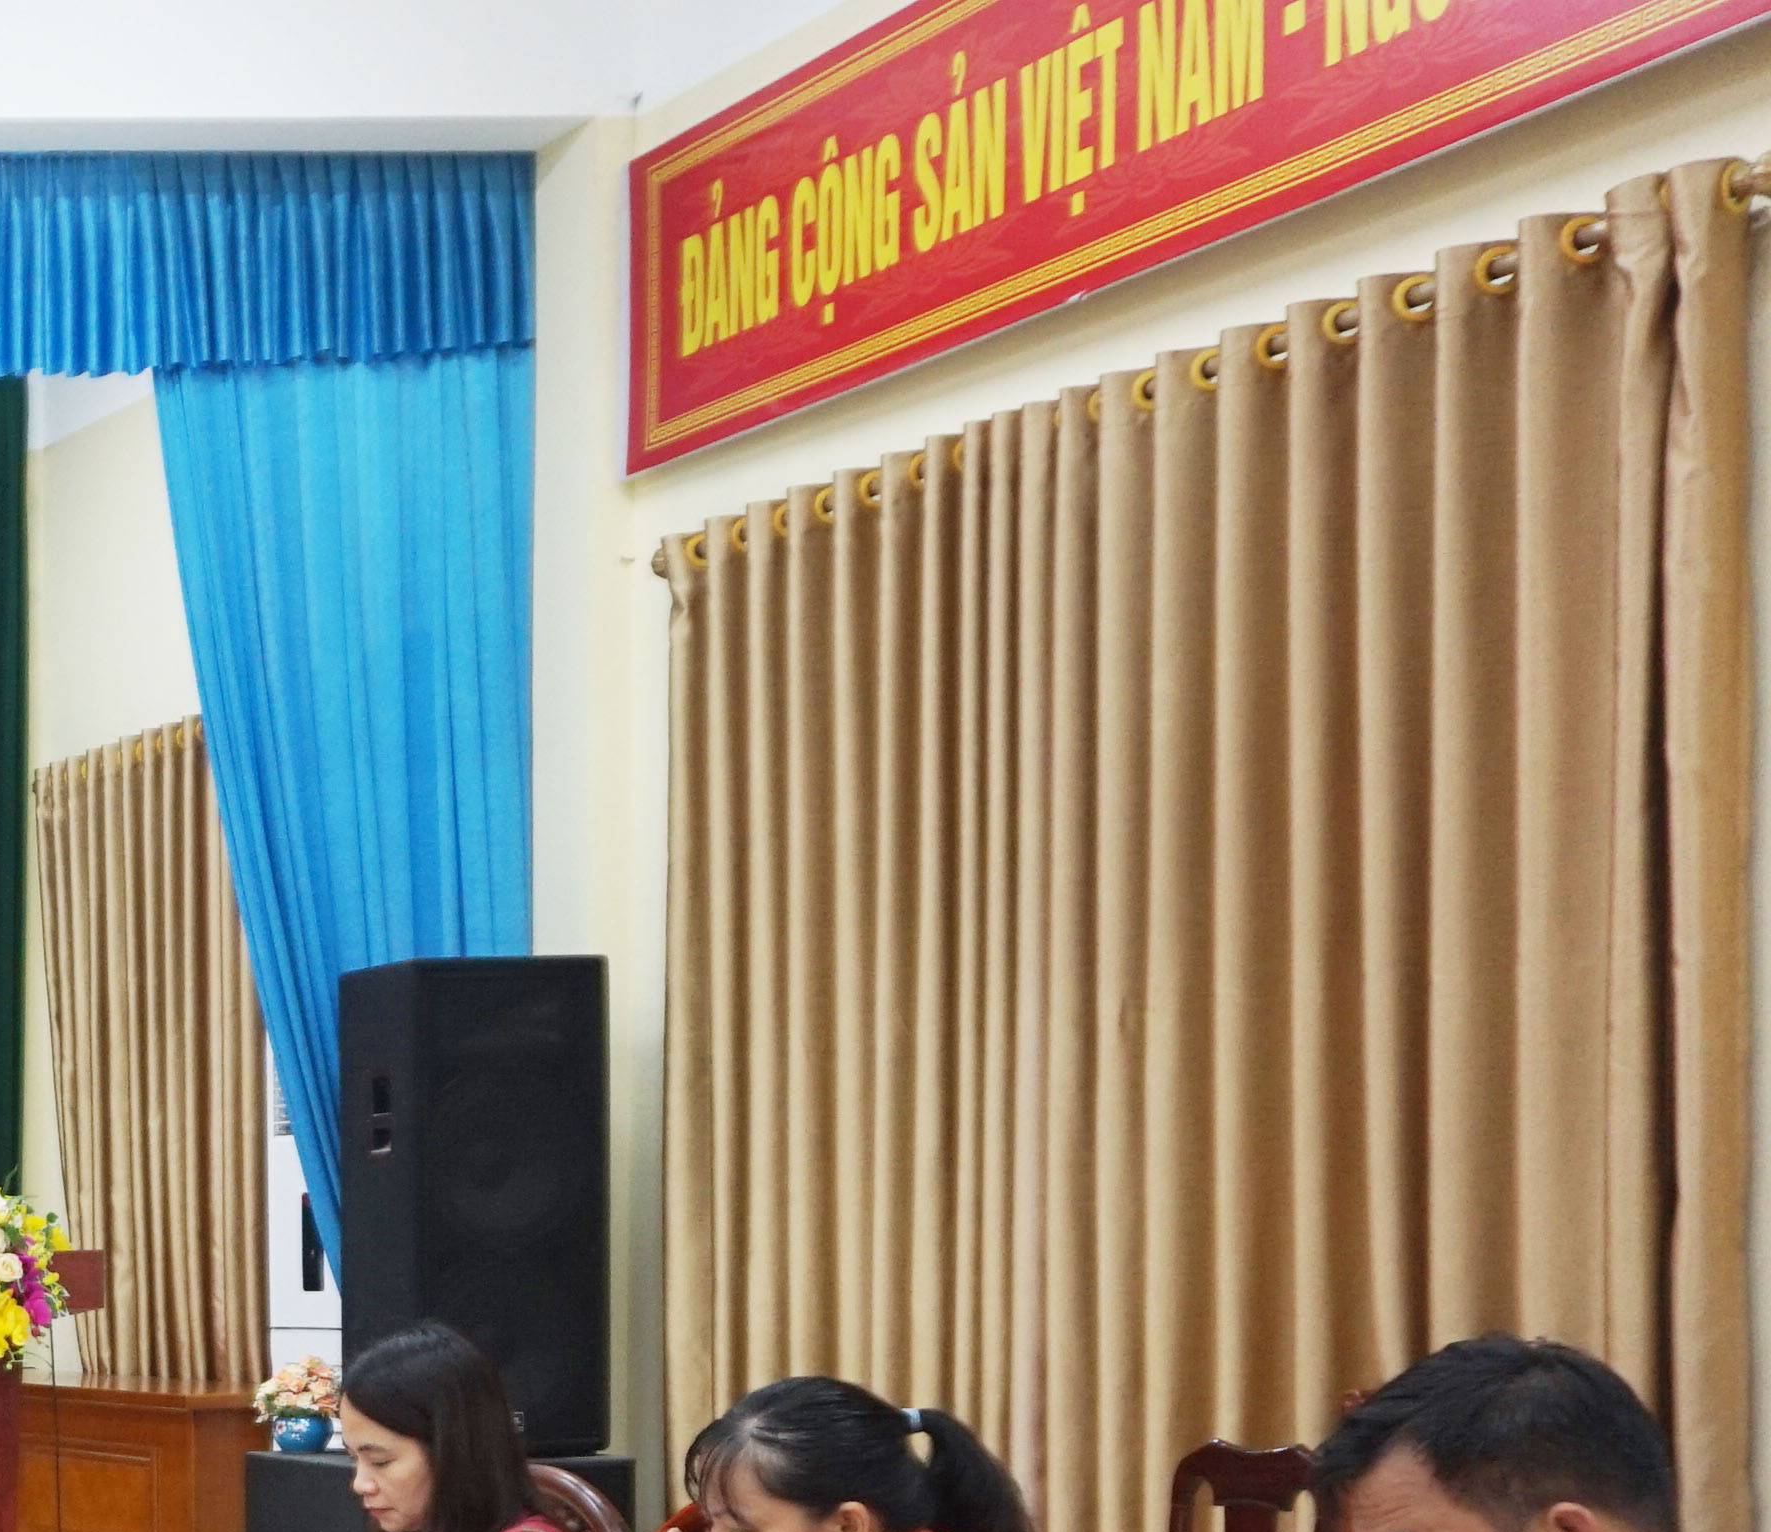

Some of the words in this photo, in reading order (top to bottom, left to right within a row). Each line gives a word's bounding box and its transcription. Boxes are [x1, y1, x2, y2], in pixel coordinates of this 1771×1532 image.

[679, 178, 779, 357] ĐẢNG
[791, 136, 901, 324] CỘNG
[913, 51, 1007, 253] SẢN
[1020, 4, 1124, 217] VIỆT
[1138, 0, 1263, 152] NAM
